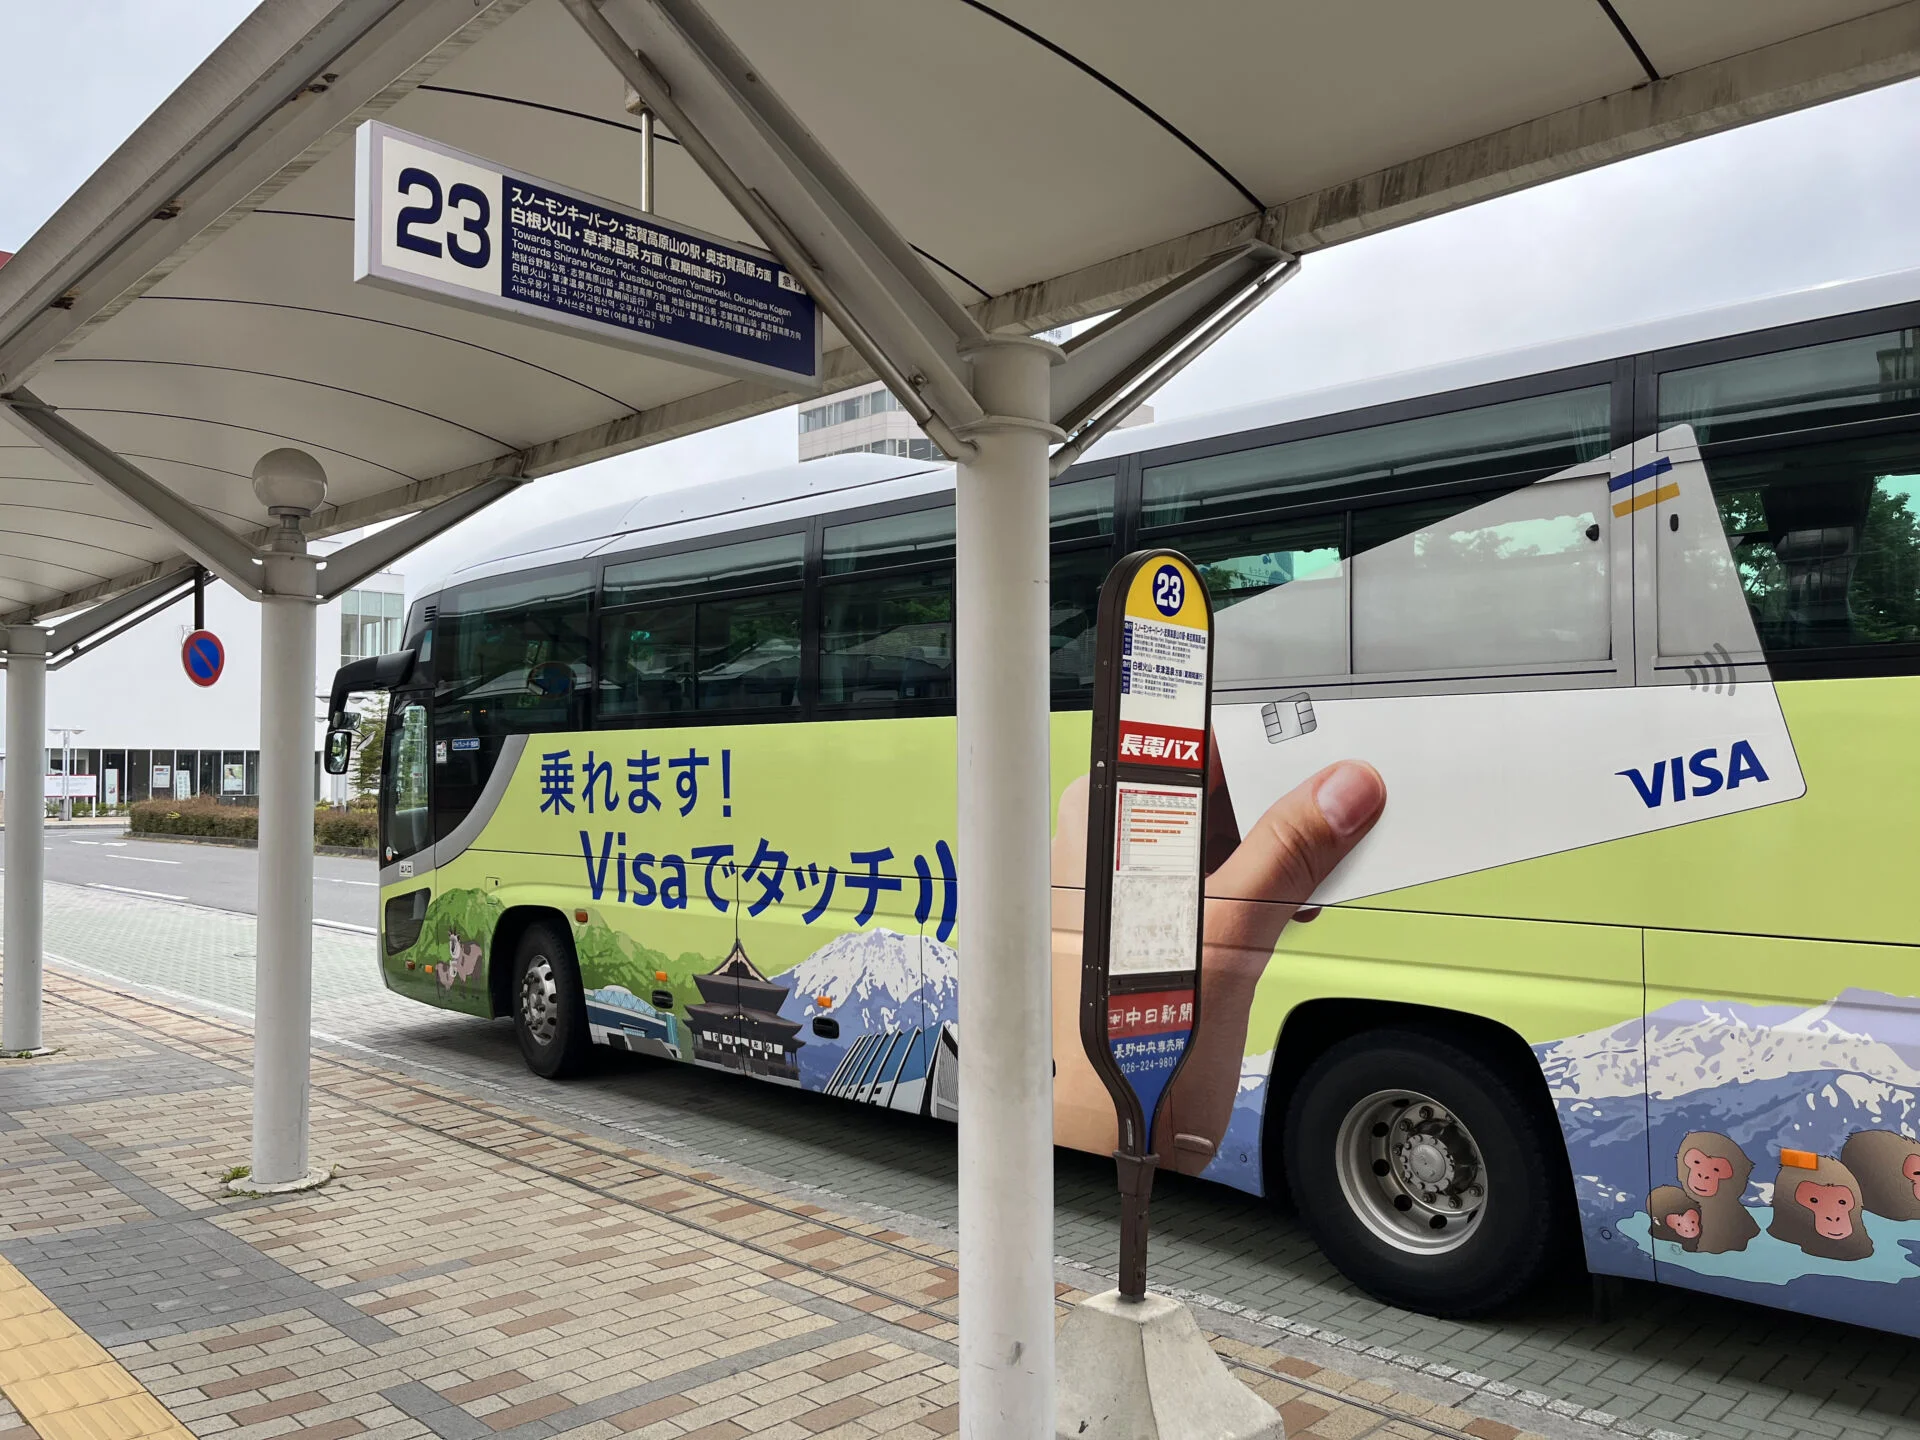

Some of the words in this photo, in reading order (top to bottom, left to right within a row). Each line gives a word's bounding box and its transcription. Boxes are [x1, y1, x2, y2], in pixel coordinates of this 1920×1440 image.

[396, 166, 491, 269] 23
[511, 226, 551, 247] Towards
[553, 238, 579, 255] Snow
[581, 247, 614, 267] Monkey
[640, 264, 687, 289] Shigakogen
[733, 292, 767, 312] Okushiga
[768, 303, 791, 319] Kogen
[511, 238, 551, 258] Towards
[553, 250, 587, 268] Shirane
[589, 261, 618, 278] Kazan,
[620, 270, 654, 287] Kusatsu
[719, 299, 746, 314] season
[747, 306, 784, 326] operation)
[1156, 572, 1182, 609] 23
[1120, 733, 1200, 762] 長電バス
[1614, 739, 1770, 809] VISA
[1126, 1002, 1193, 1028] 中日新聞
